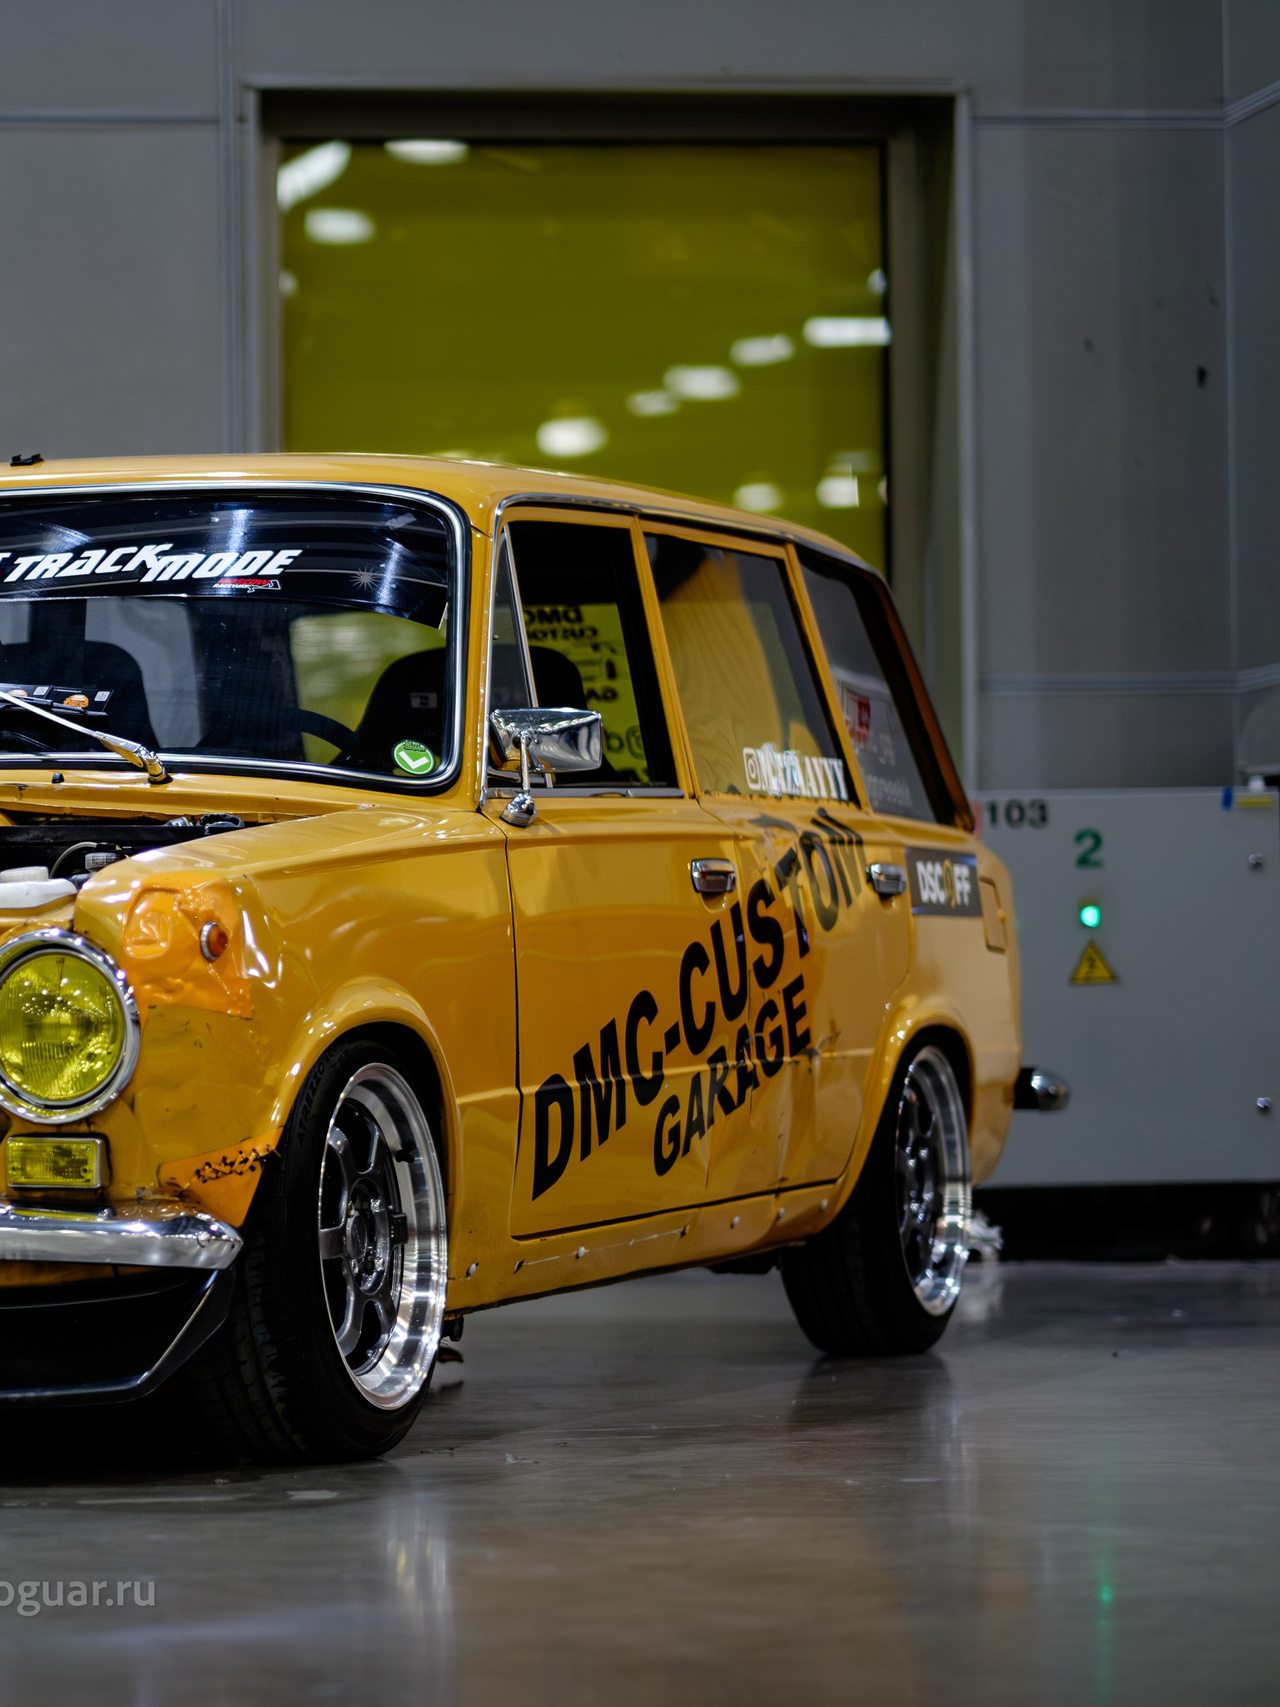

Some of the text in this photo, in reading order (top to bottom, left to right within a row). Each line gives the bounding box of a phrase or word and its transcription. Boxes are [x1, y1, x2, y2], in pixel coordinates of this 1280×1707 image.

[987, 800, 1049, 829] 103
[1074, 827, 1105, 869] 2
[653, 973, 812, 1177] GARAGE
